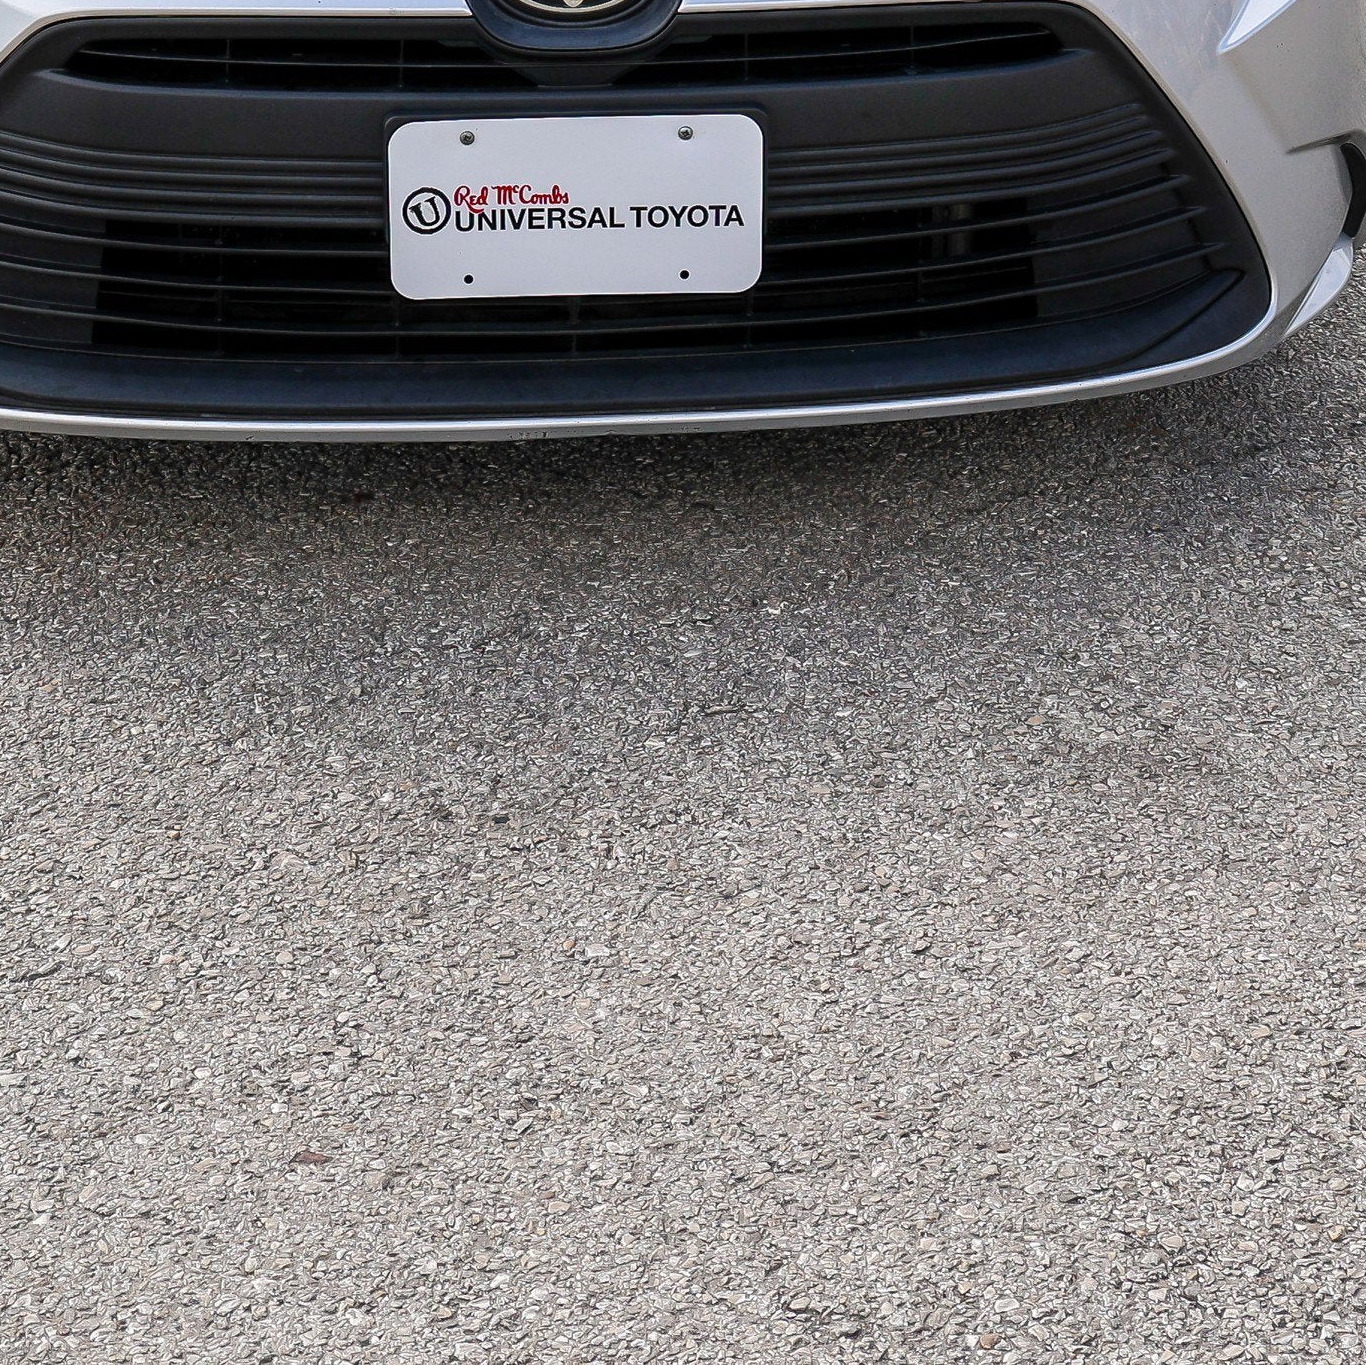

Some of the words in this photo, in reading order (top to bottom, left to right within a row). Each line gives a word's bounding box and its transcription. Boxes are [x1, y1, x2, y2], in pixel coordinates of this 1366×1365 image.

[453, 185, 489, 214] Red
[491, 184, 569, 206] McCombs
[455, 206, 625, 232] UNIVERSAL
[630, 204, 745, 228] TOYOTA
